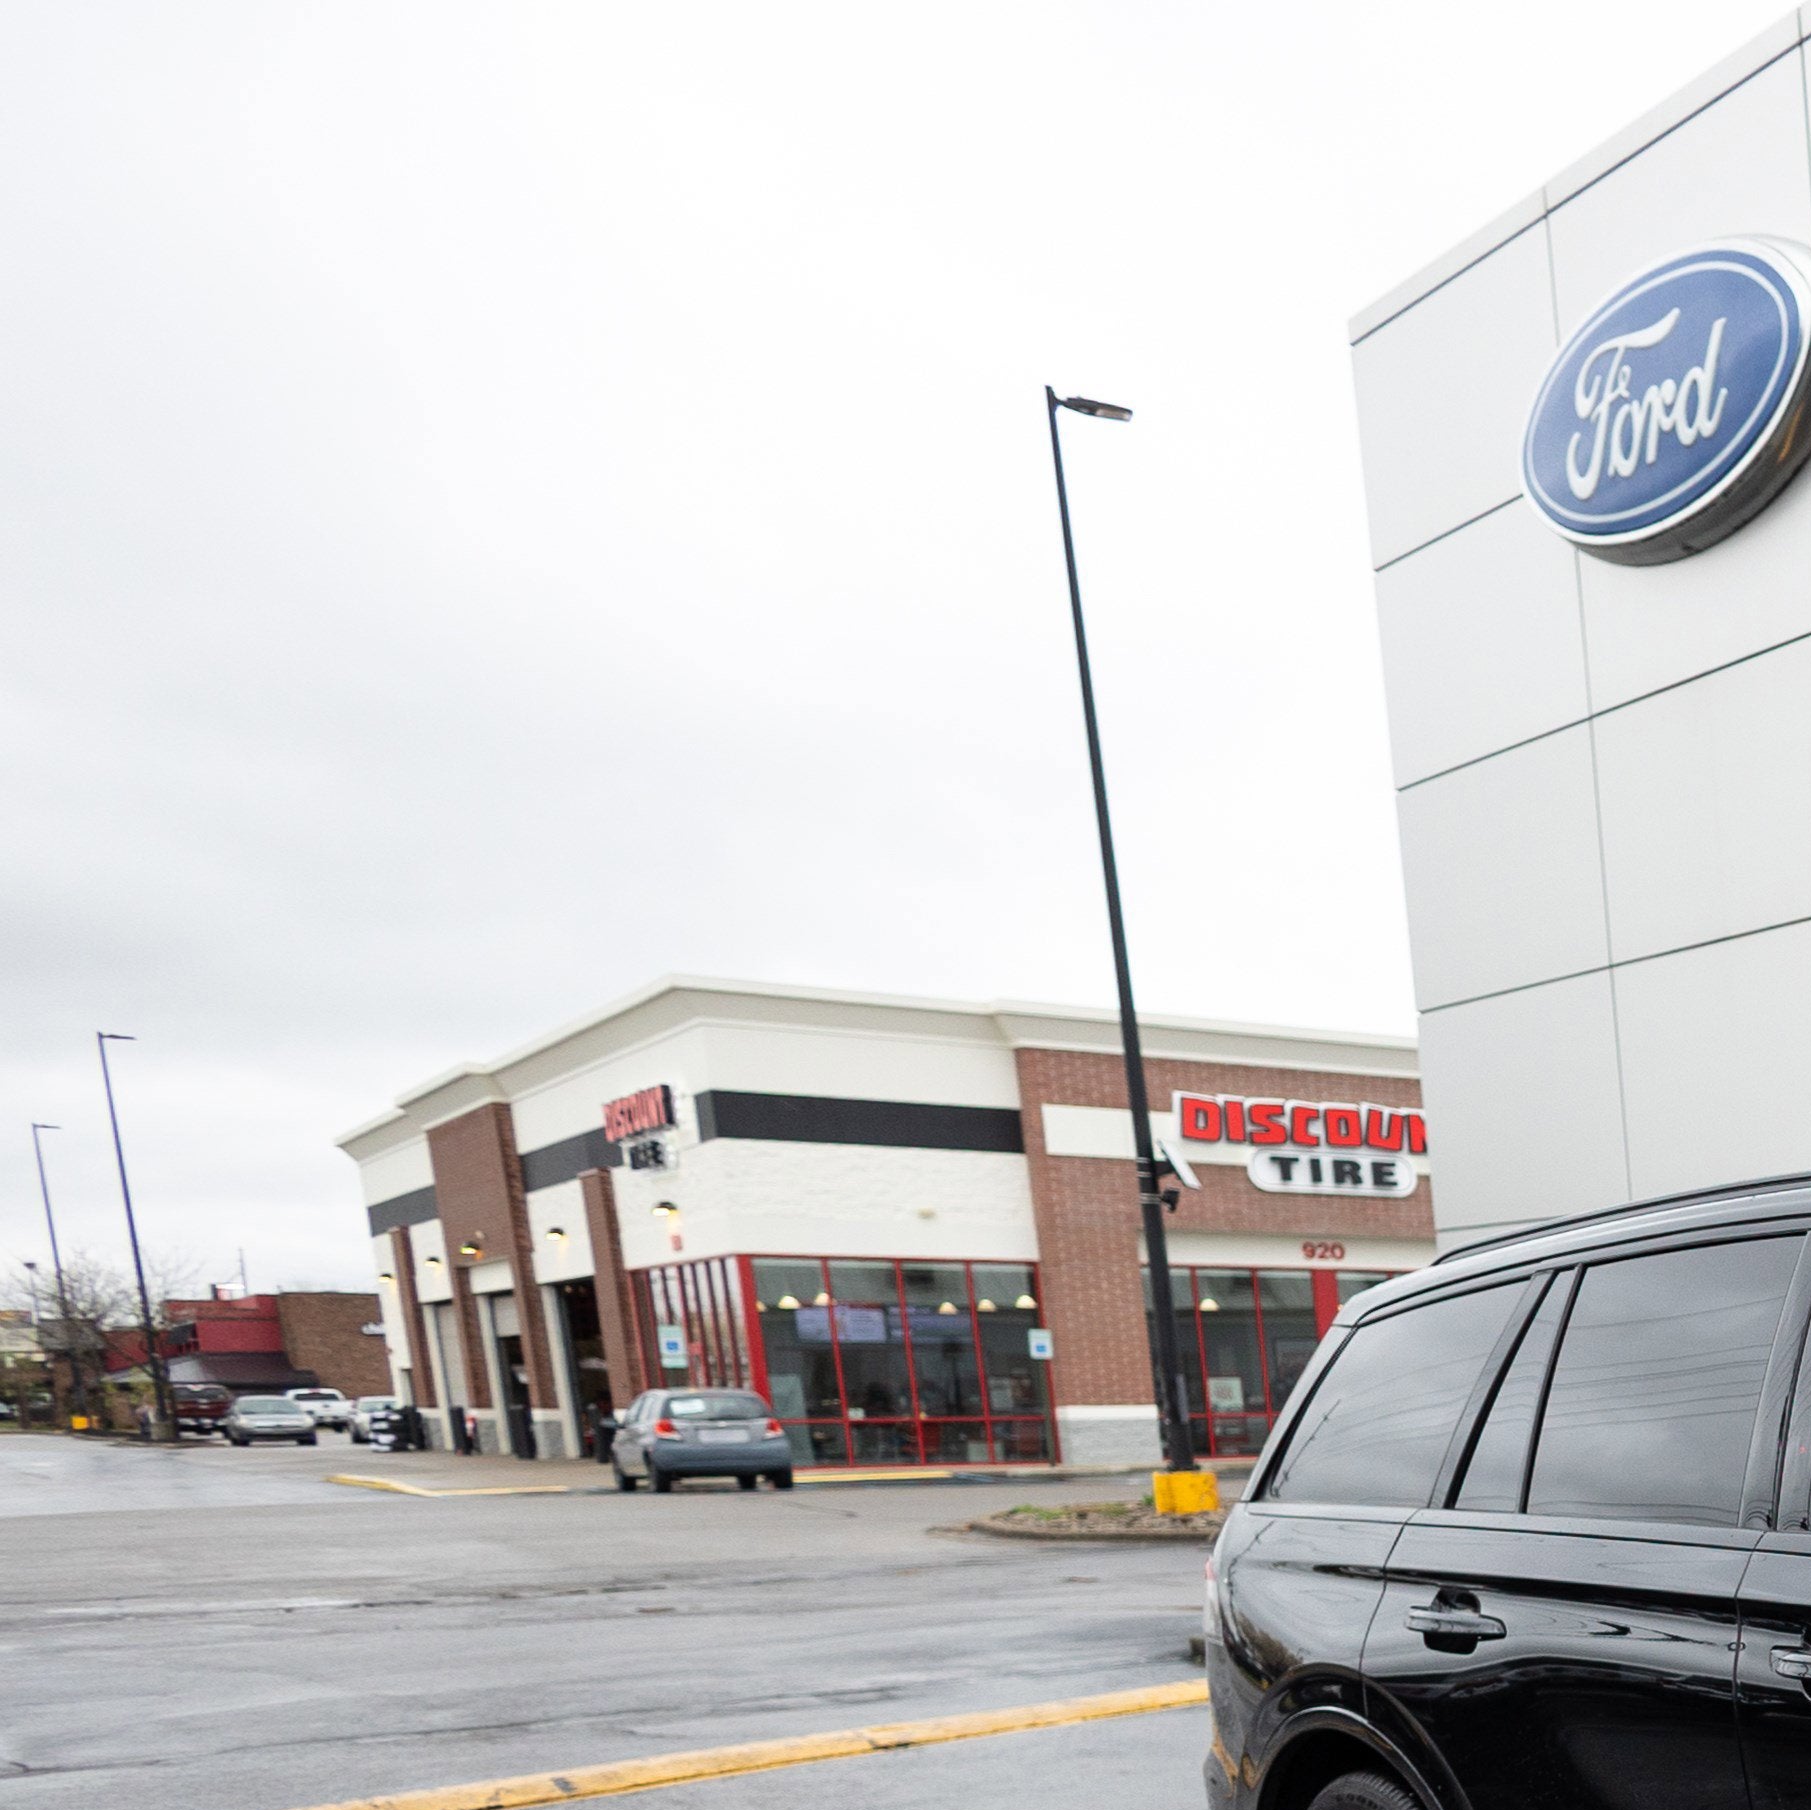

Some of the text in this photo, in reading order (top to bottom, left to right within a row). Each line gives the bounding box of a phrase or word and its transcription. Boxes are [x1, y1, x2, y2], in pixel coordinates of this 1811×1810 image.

[1565, 306, 1728, 500] Ford
[1270, 1156, 1398, 1186] TIRE
[1302, 1242, 1345, 1260] 920
